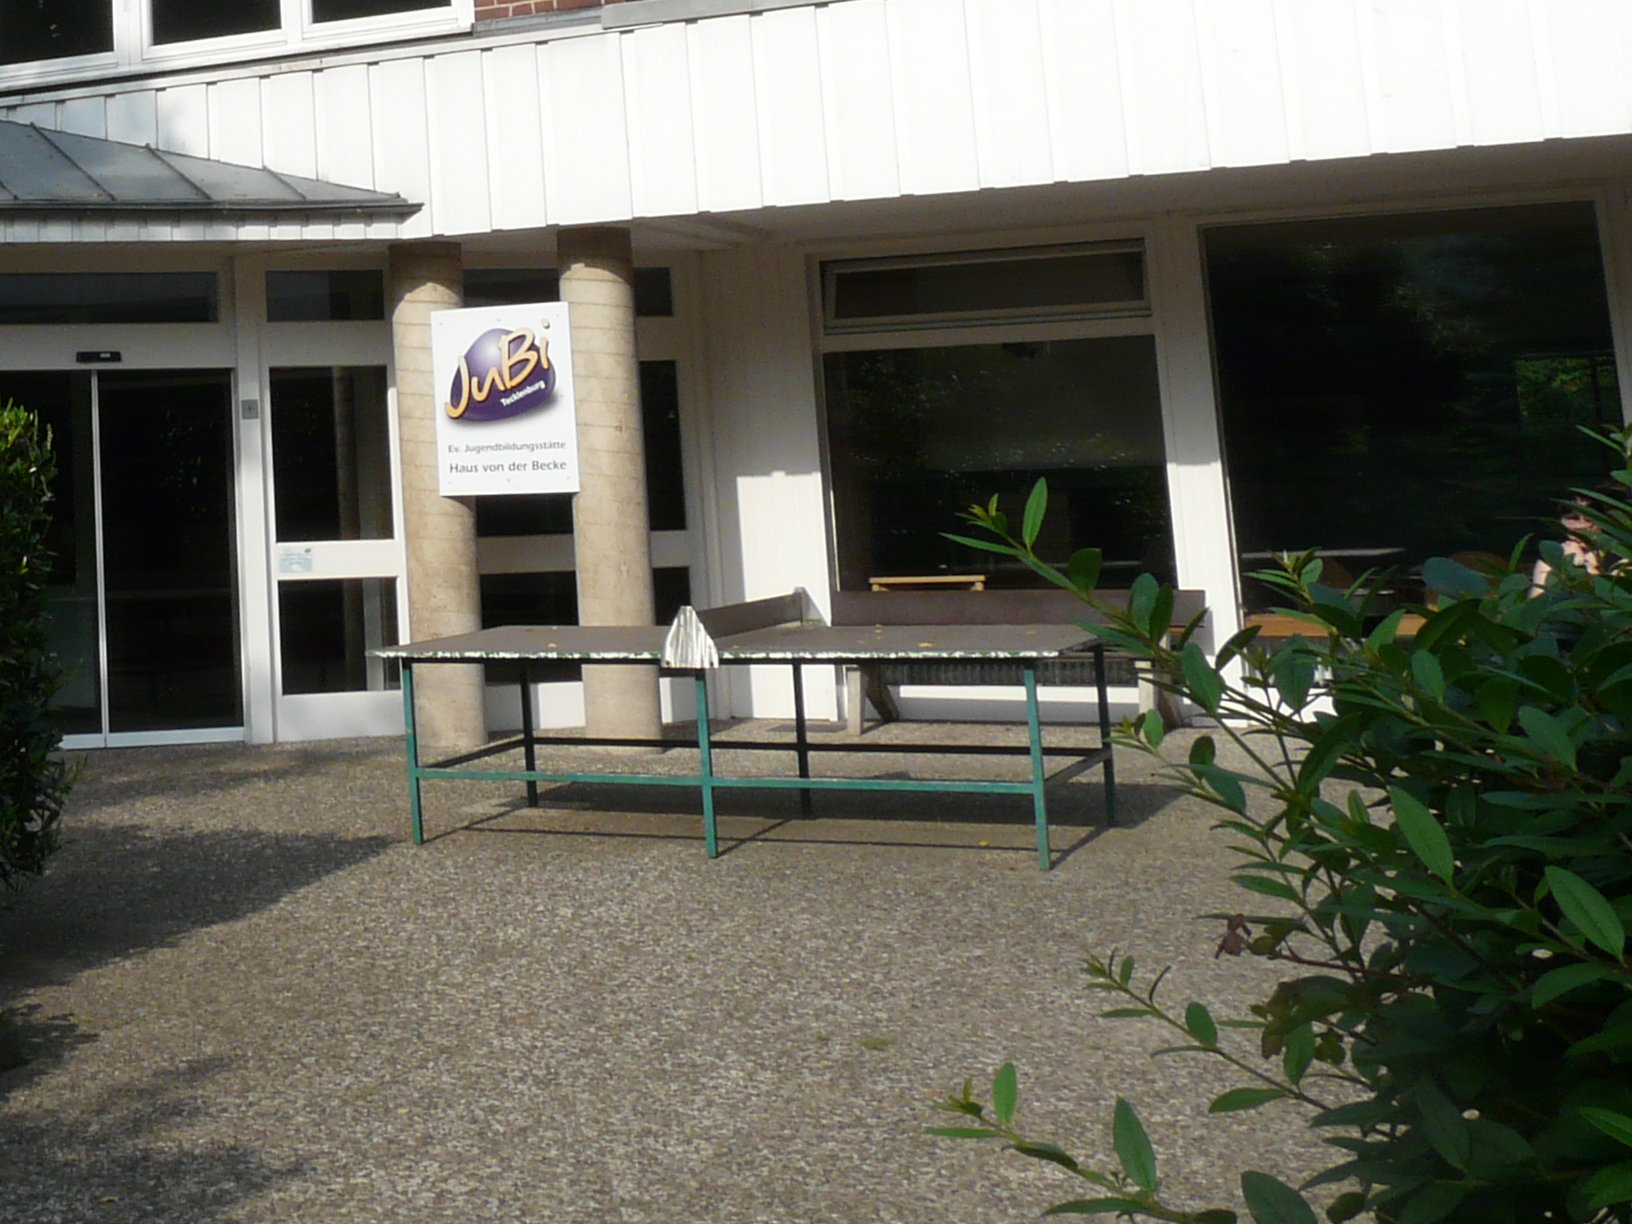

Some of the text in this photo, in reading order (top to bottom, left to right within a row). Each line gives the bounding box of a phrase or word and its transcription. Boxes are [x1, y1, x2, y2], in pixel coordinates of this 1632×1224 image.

[445, 319, 550, 419] JuBi
[448, 441, 566, 454] Ev. Jugendbildungsstätte
[449, 459, 567, 473] Haus von der Becke
